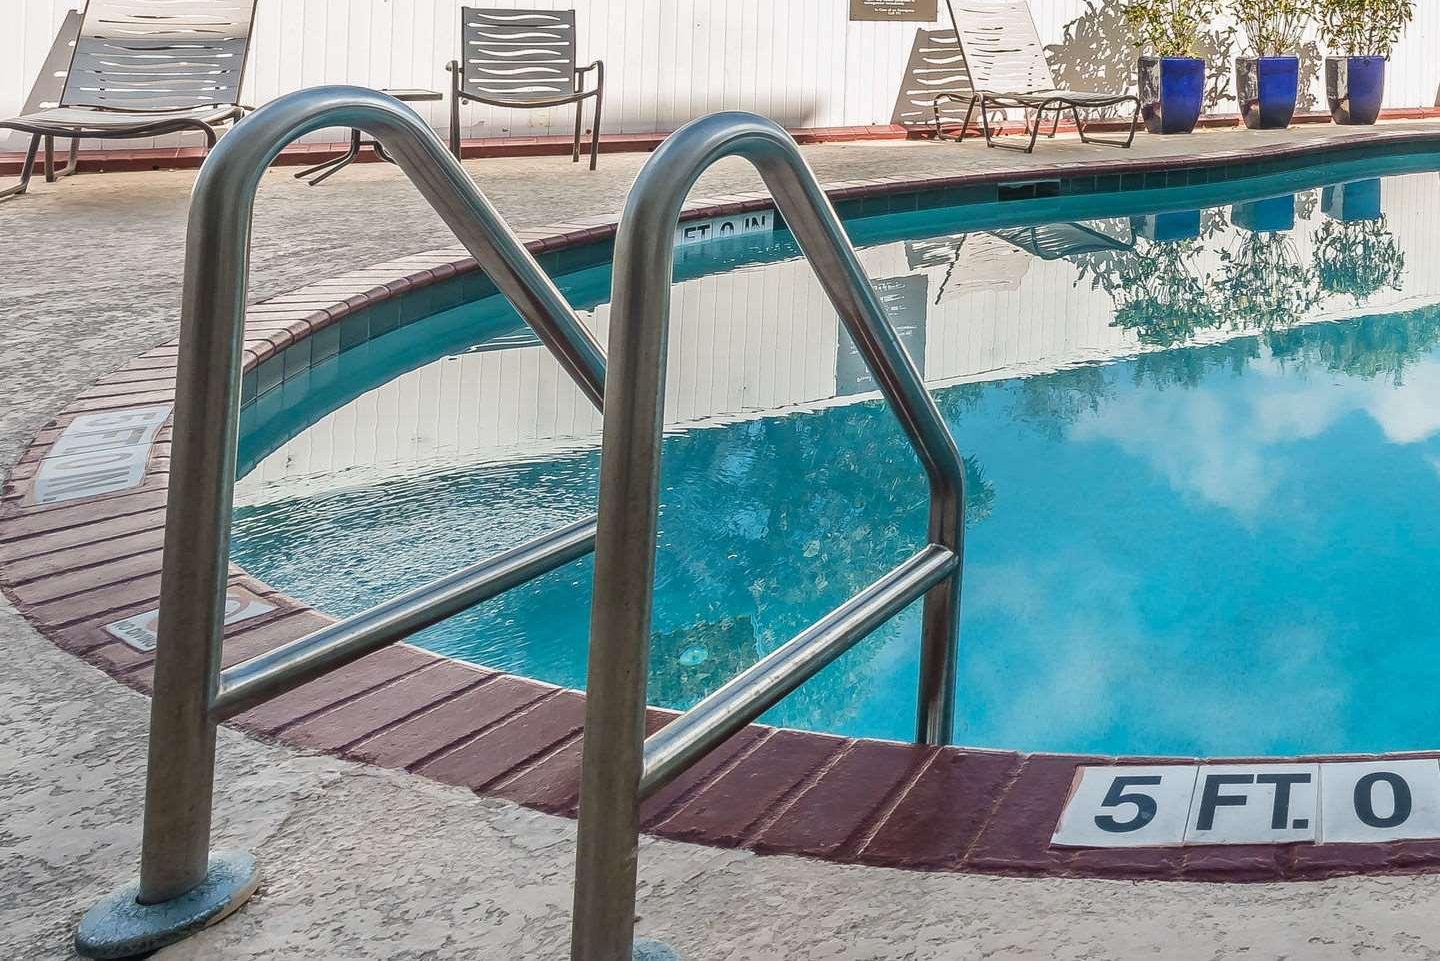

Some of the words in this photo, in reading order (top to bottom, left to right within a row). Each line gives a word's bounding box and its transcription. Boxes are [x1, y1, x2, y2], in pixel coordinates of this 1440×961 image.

[1094, 775, 1163, 833] 5
[1196, 773, 1312, 831] FT.
[1353, 771, 1413, 829] 0
